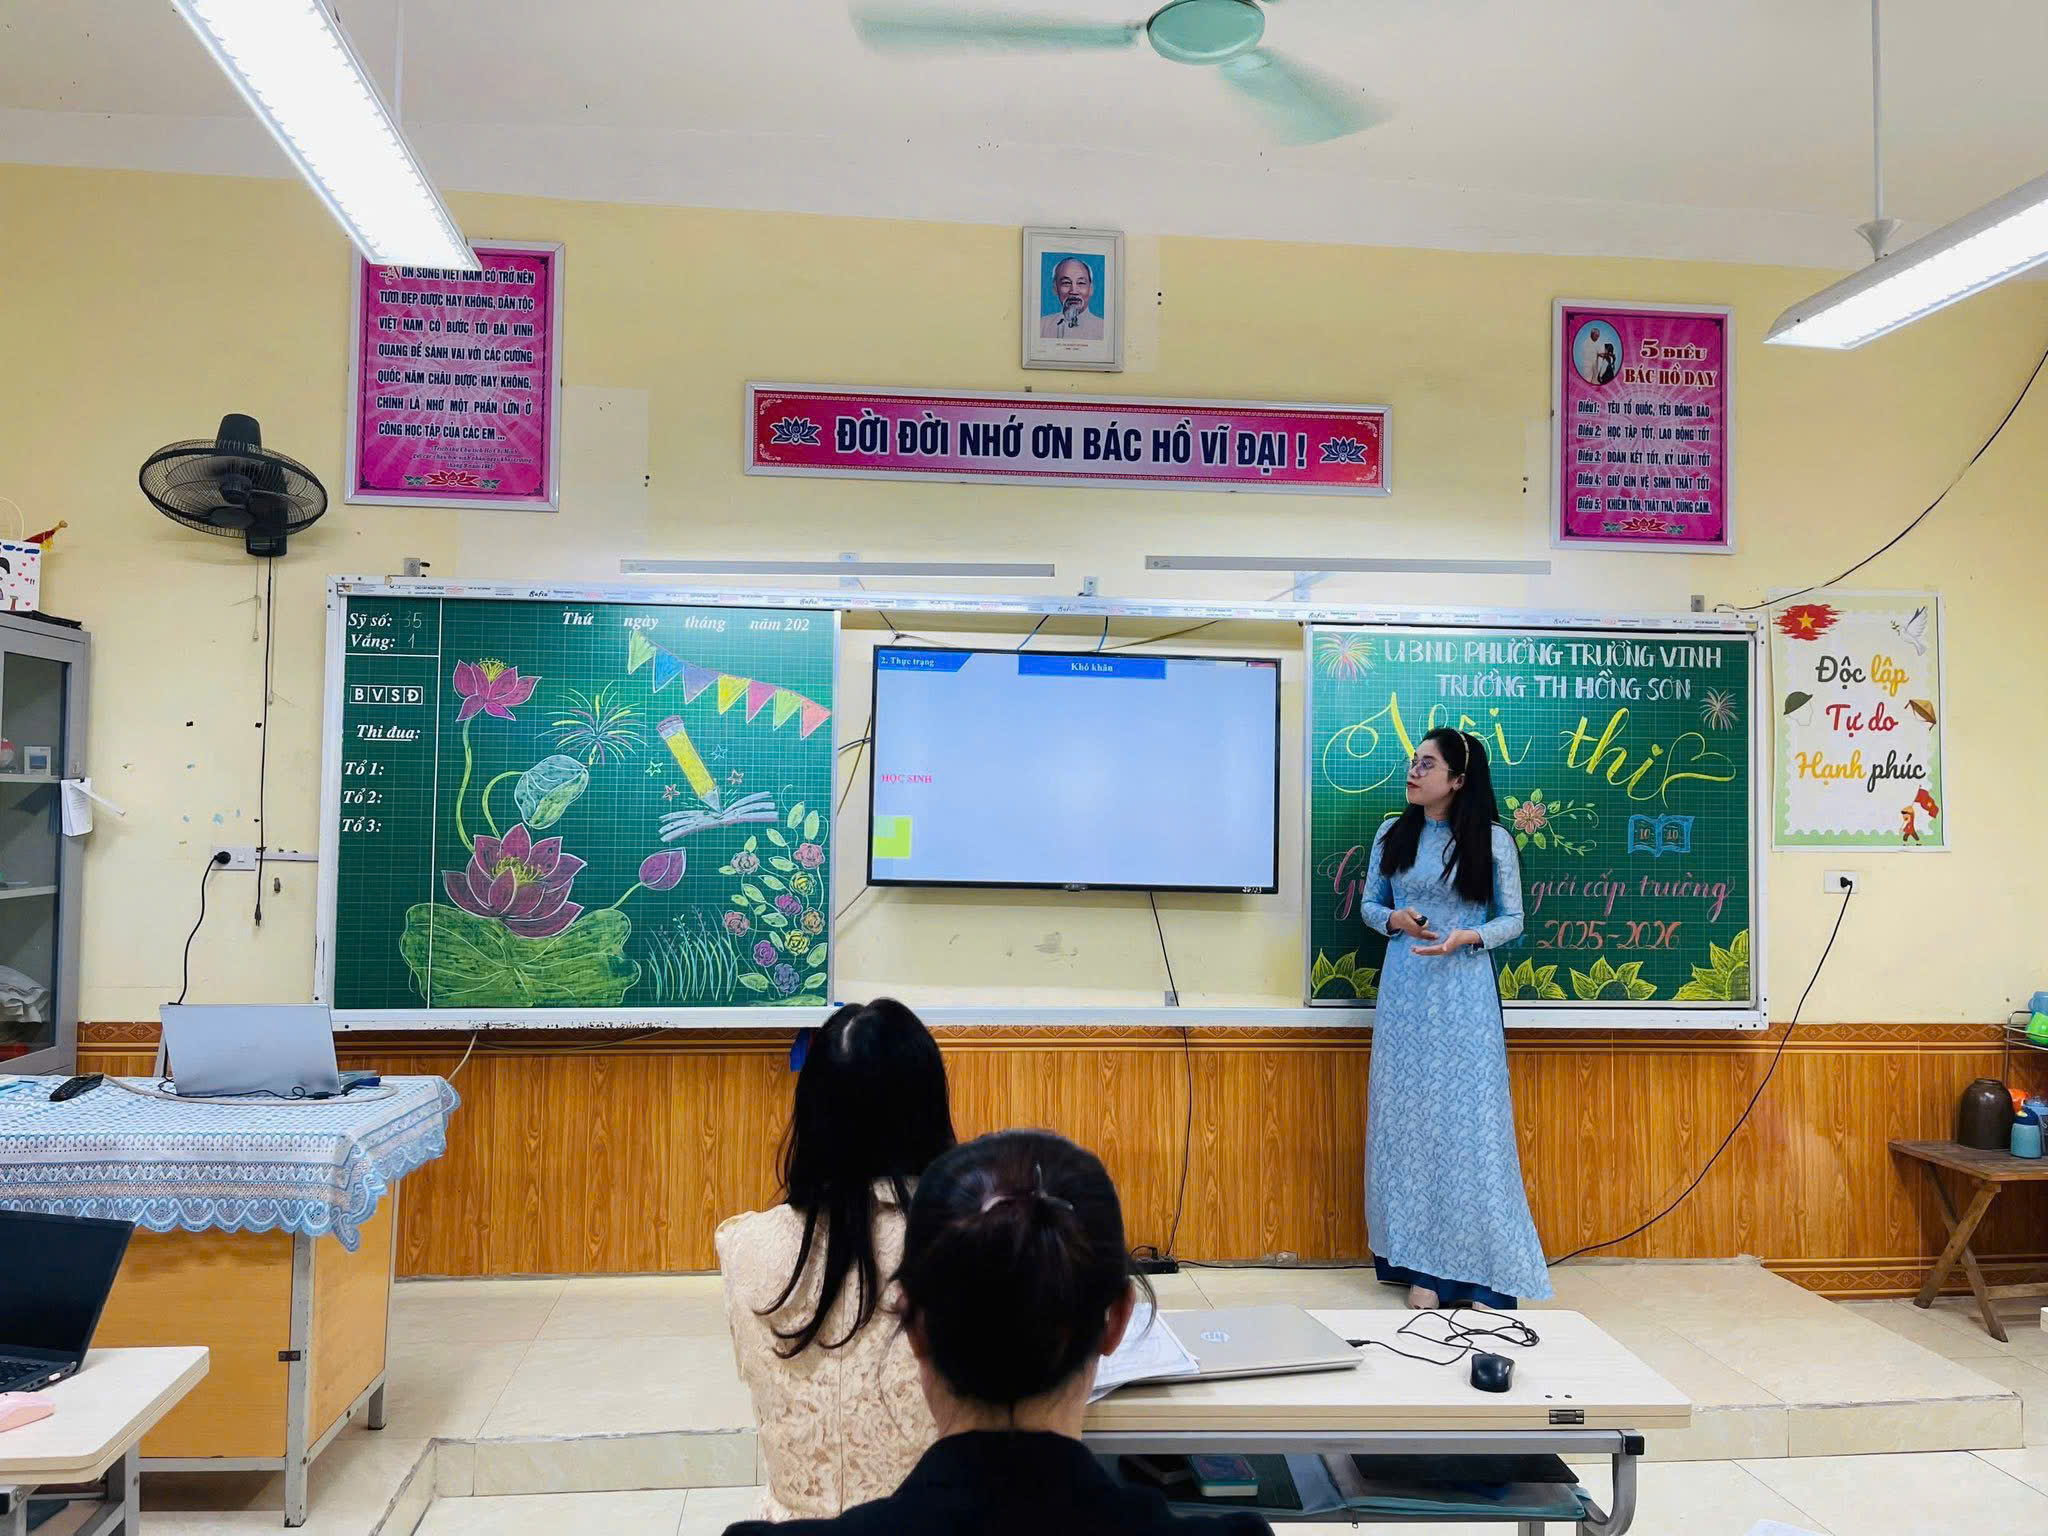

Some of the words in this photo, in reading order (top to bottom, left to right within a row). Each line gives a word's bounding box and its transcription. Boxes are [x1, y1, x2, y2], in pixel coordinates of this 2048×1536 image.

[462, 270, 482, 281] NAM
[485, 270, 496, 282] CÓ
[499, 266, 514, 283] TRỞ
[517, 270, 534, 284] NÊN
[380, 291, 399, 303] TƯƠI
[401, 292, 418, 307] ĐẸP
[421, 293, 443, 308] ĐƯỢC
[446, 295, 462, 306] HAY
[464, 294, 496, 309] KHÔNG,
[499, 295, 515, 309] DÂN
[518, 297, 533, 313] TỘC
[379, 316, 397, 332] VIỆT
[403, 319, 423, 331] NAM
[429, 318, 440, 332] CÓ
[447, 319, 469, 333] BƯỚC
[475, 320, 488, 334] TỚI
[514, 324, 533, 336] VINH
[378, 344, 408, 357] QUANG
[411, 341, 423, 357] ĐỂ
[425, 345, 448, 359] SÁNH
[451, 347, 465, 360] VAI
[468, 345, 482, 360] VỚI
[484, 346, 500, 361] CÁC
[504, 347, 533, 362] CƯỜNG
[1641, 340, 1659, 358] 5
[378, 367, 401, 382] QUỐC
[405, 370, 425, 384] NĂM
[428, 372, 451, 385] CHÂU
[455, 373, 478, 389] ĐƯỢC
[481, 375, 498, 387] HAY
[501, 375, 532, 390] KHÔNG,
[1625, 367, 1655, 384] BÁC
[1659, 363, 1682, 385] HỒ
[1684, 371, 1716, 390] DẠY
[377, 395, 403, 409] CHÍNH
[410, 396, 420, 410] LÀ
[426, 397, 444, 411] NHỜ
[450, 398, 469, 415] MỘT
[503, 400, 519, 414] LỚN
[526, 398, 532, 414] Ở
[379, 422, 402, 436] CÔNG
[405, 425, 422, 438] HỌC
[425, 424, 440, 439] TẬP
[443, 421, 460, 438] CỦA
[462, 425, 479, 439] CÁC
[482, 428, 495, 440] EM
[1608, 426, 1621, 440] HỌC
[1626, 425, 1637, 440] TẬP
[1659, 428, 1672, 439] LAO
[1675, 427, 1694, 442] ĐỘNG
[837, 410, 889, 454] ĐỜI
[899, 412, 949, 457] ĐỜI
[960, 414, 1023, 458] NHỚ
[1031, 421, 1073, 461] ƠN
[1083, 416, 1142, 463] BÁC
[1153, 419, 1194, 464] HỒ
[1199, 426, 1231, 465] VĨ
[1237, 432, 1287, 475] ĐẠI
[1299, 434, 1306, 468] !
[1641, 474, 1649, 491] VỆ
[1654, 478, 1671, 488] SINH
[1676, 476, 1692, 491] THẬT
[348, 612, 367, 629] Sỹ
[371, 613, 392, 627] số:
[562, 610, 594, 626] Thứ
[623, 616, 659, 630] ngày
[685, 616, 726, 632] tháng
[751, 619, 780, 631] năm
[784, 618, 810, 631] 202
[351, 633, 395, 650] Vắng:
[1465, 639, 1564, 667] PHƯỜNG
[1569, 641, 1656, 668] TRƯỜNG
[1660, 646, 1721, 668] VINH
[1071, 662, 1089, 671] Khó
[1815, 655, 1866, 689] Độc
[1871, 654, 1909, 697] lập
[1439, 669, 1526, 698] TRƯỜNG
[1535, 676, 1567, 699] TH
[1576, 670, 1642, 700] HỒNG
[1647, 678, 1691, 700] SƠN
[1826, 703, 1863, 737] Tự
[1868, 702, 1899, 731] do
[356, 725, 383, 739] Thi
[386, 725, 420, 739] đua:
[1558, 706, 1737, 809] thi
[345, 760, 367, 776] Tổ
[371, 762, 384, 775] 1:
[1795, 749, 1866, 785] Hạnh
[1867, 749, 1926, 793] phúc
[906, 774, 933, 784] SINH
[343, 789, 366, 804] Tổ
[368, 791, 383, 804] 2:
[342, 817, 365, 833] Tổ
[367, 819, 381, 833] 3:
[1536, 920, 1682, 950] 2025-2026
